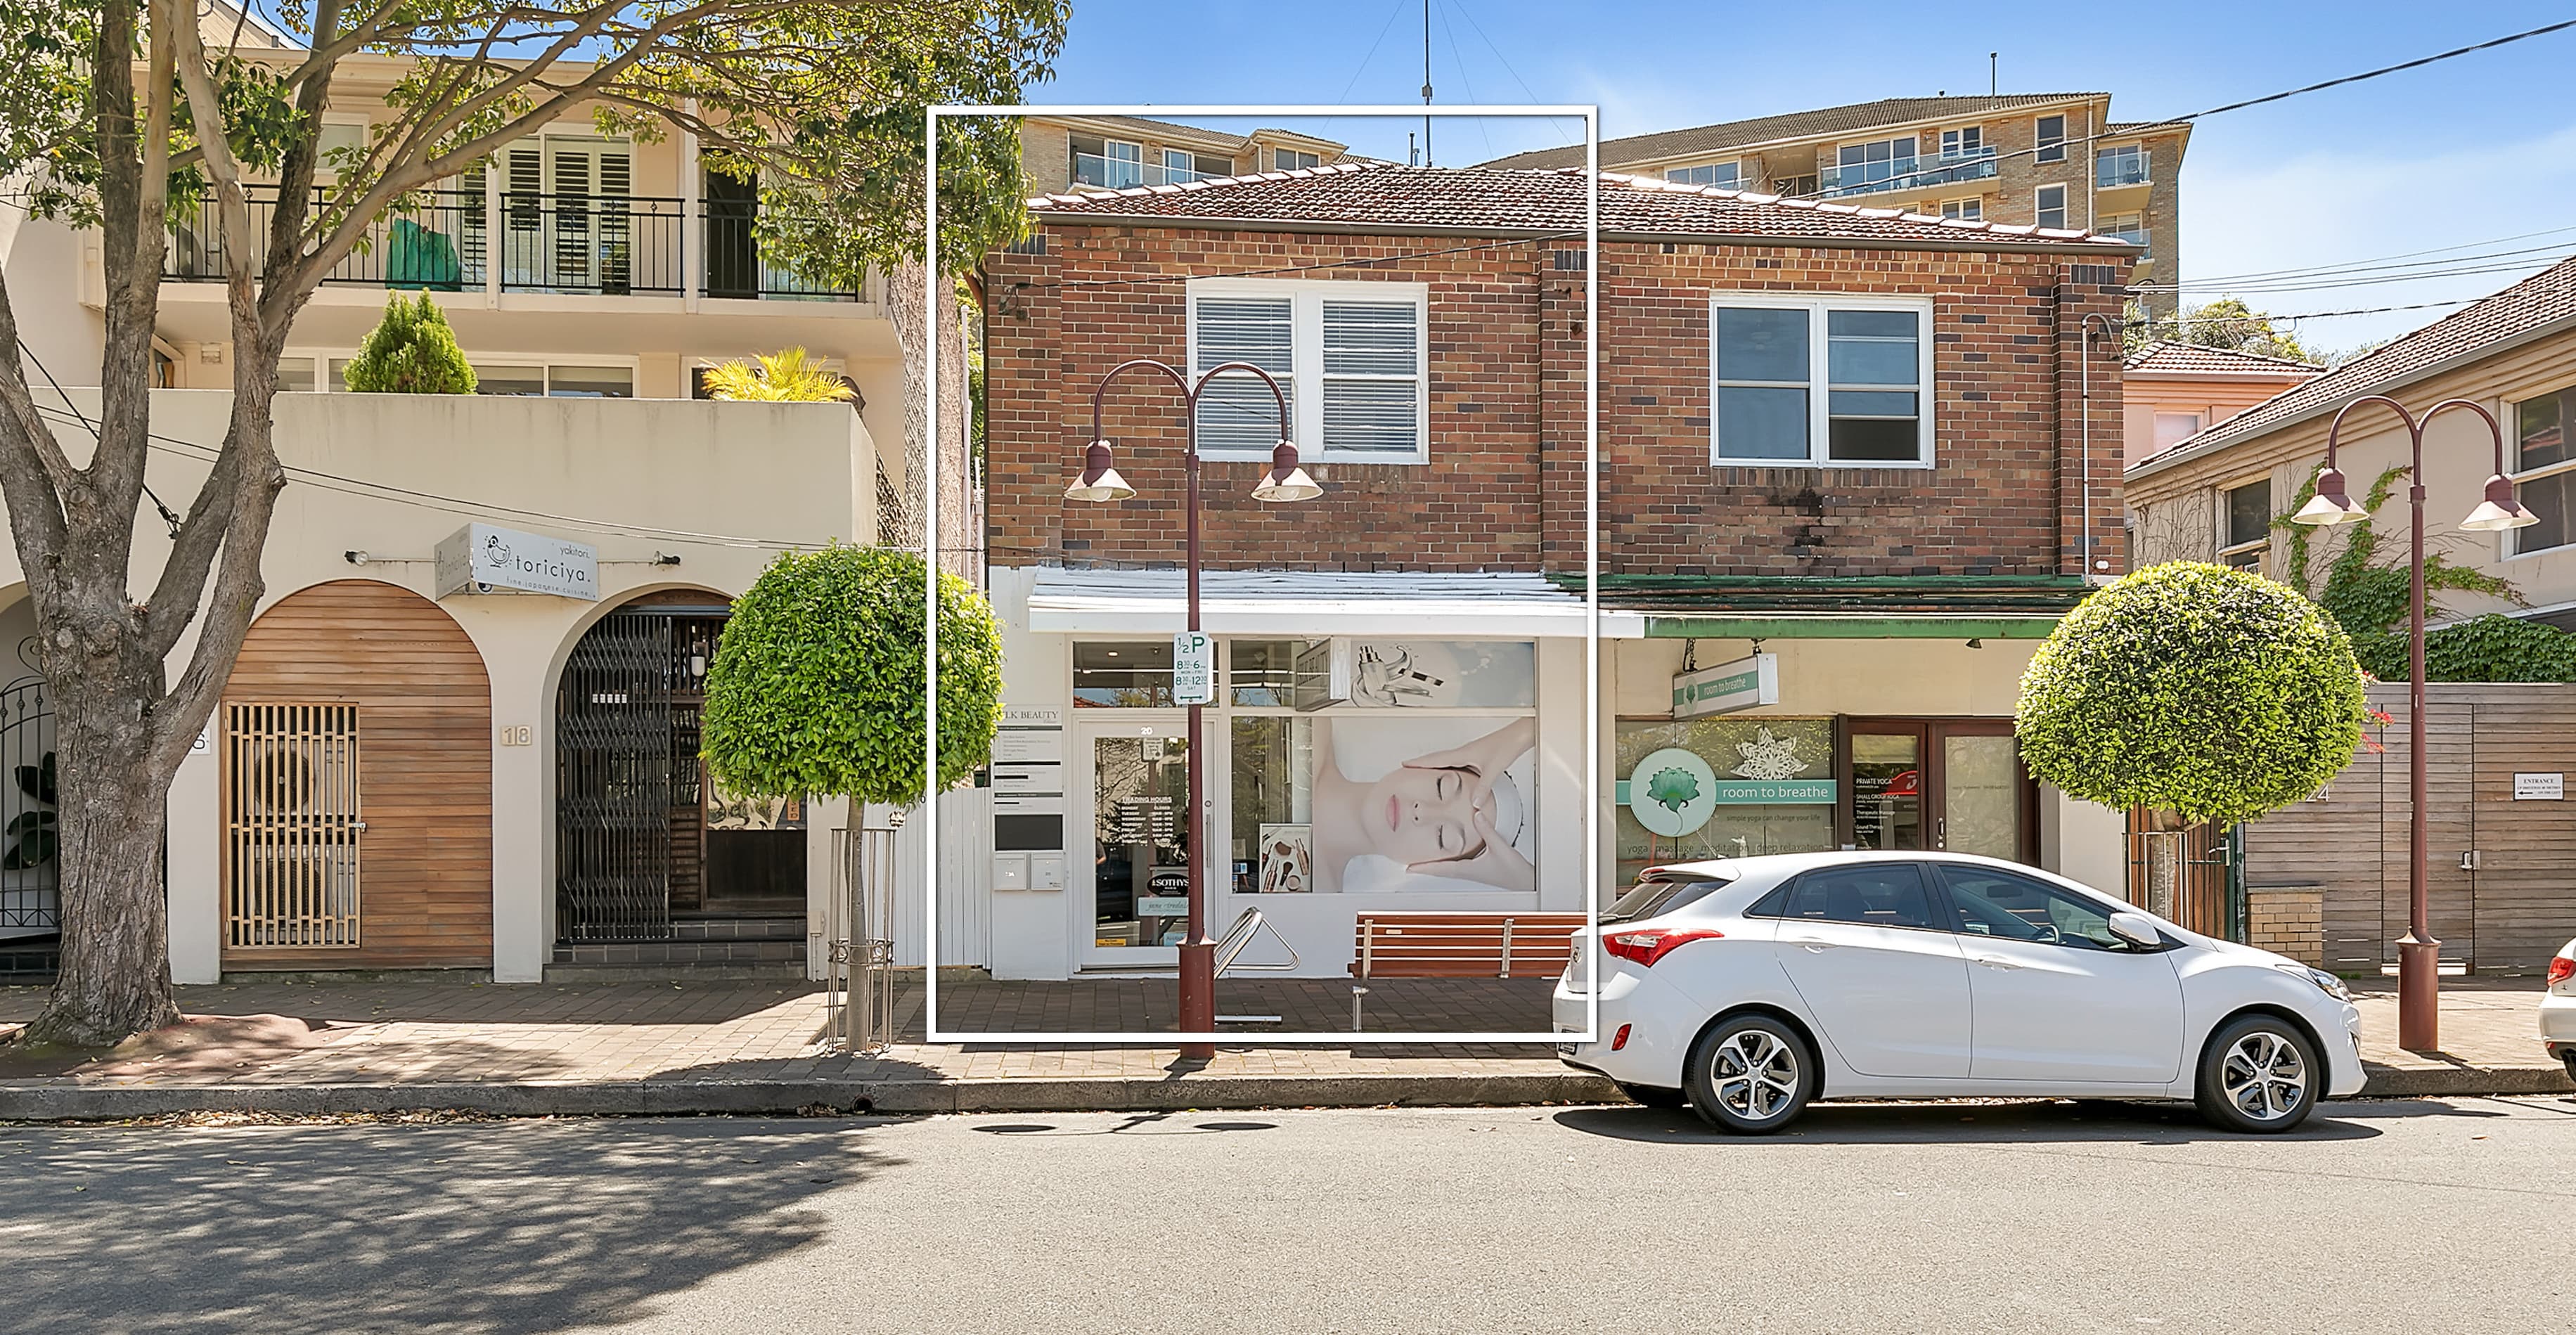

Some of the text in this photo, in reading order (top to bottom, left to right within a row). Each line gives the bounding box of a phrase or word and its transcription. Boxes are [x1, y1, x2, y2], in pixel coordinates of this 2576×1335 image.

[516, 555, 591, 583] toriciya.
[1704, 676, 1746, 696] room to breathe
[504, 728, 529, 744] 18
[1140, 726, 1153, 735] 20
[1722, 786, 1829, 798] room to breathe
[1774, 814, 1795, 823] change
[1627, 845, 1649, 855] yoga
[1656, 845, 1694, 855] masage
[1780, 844, 1824, 852] relaxation
